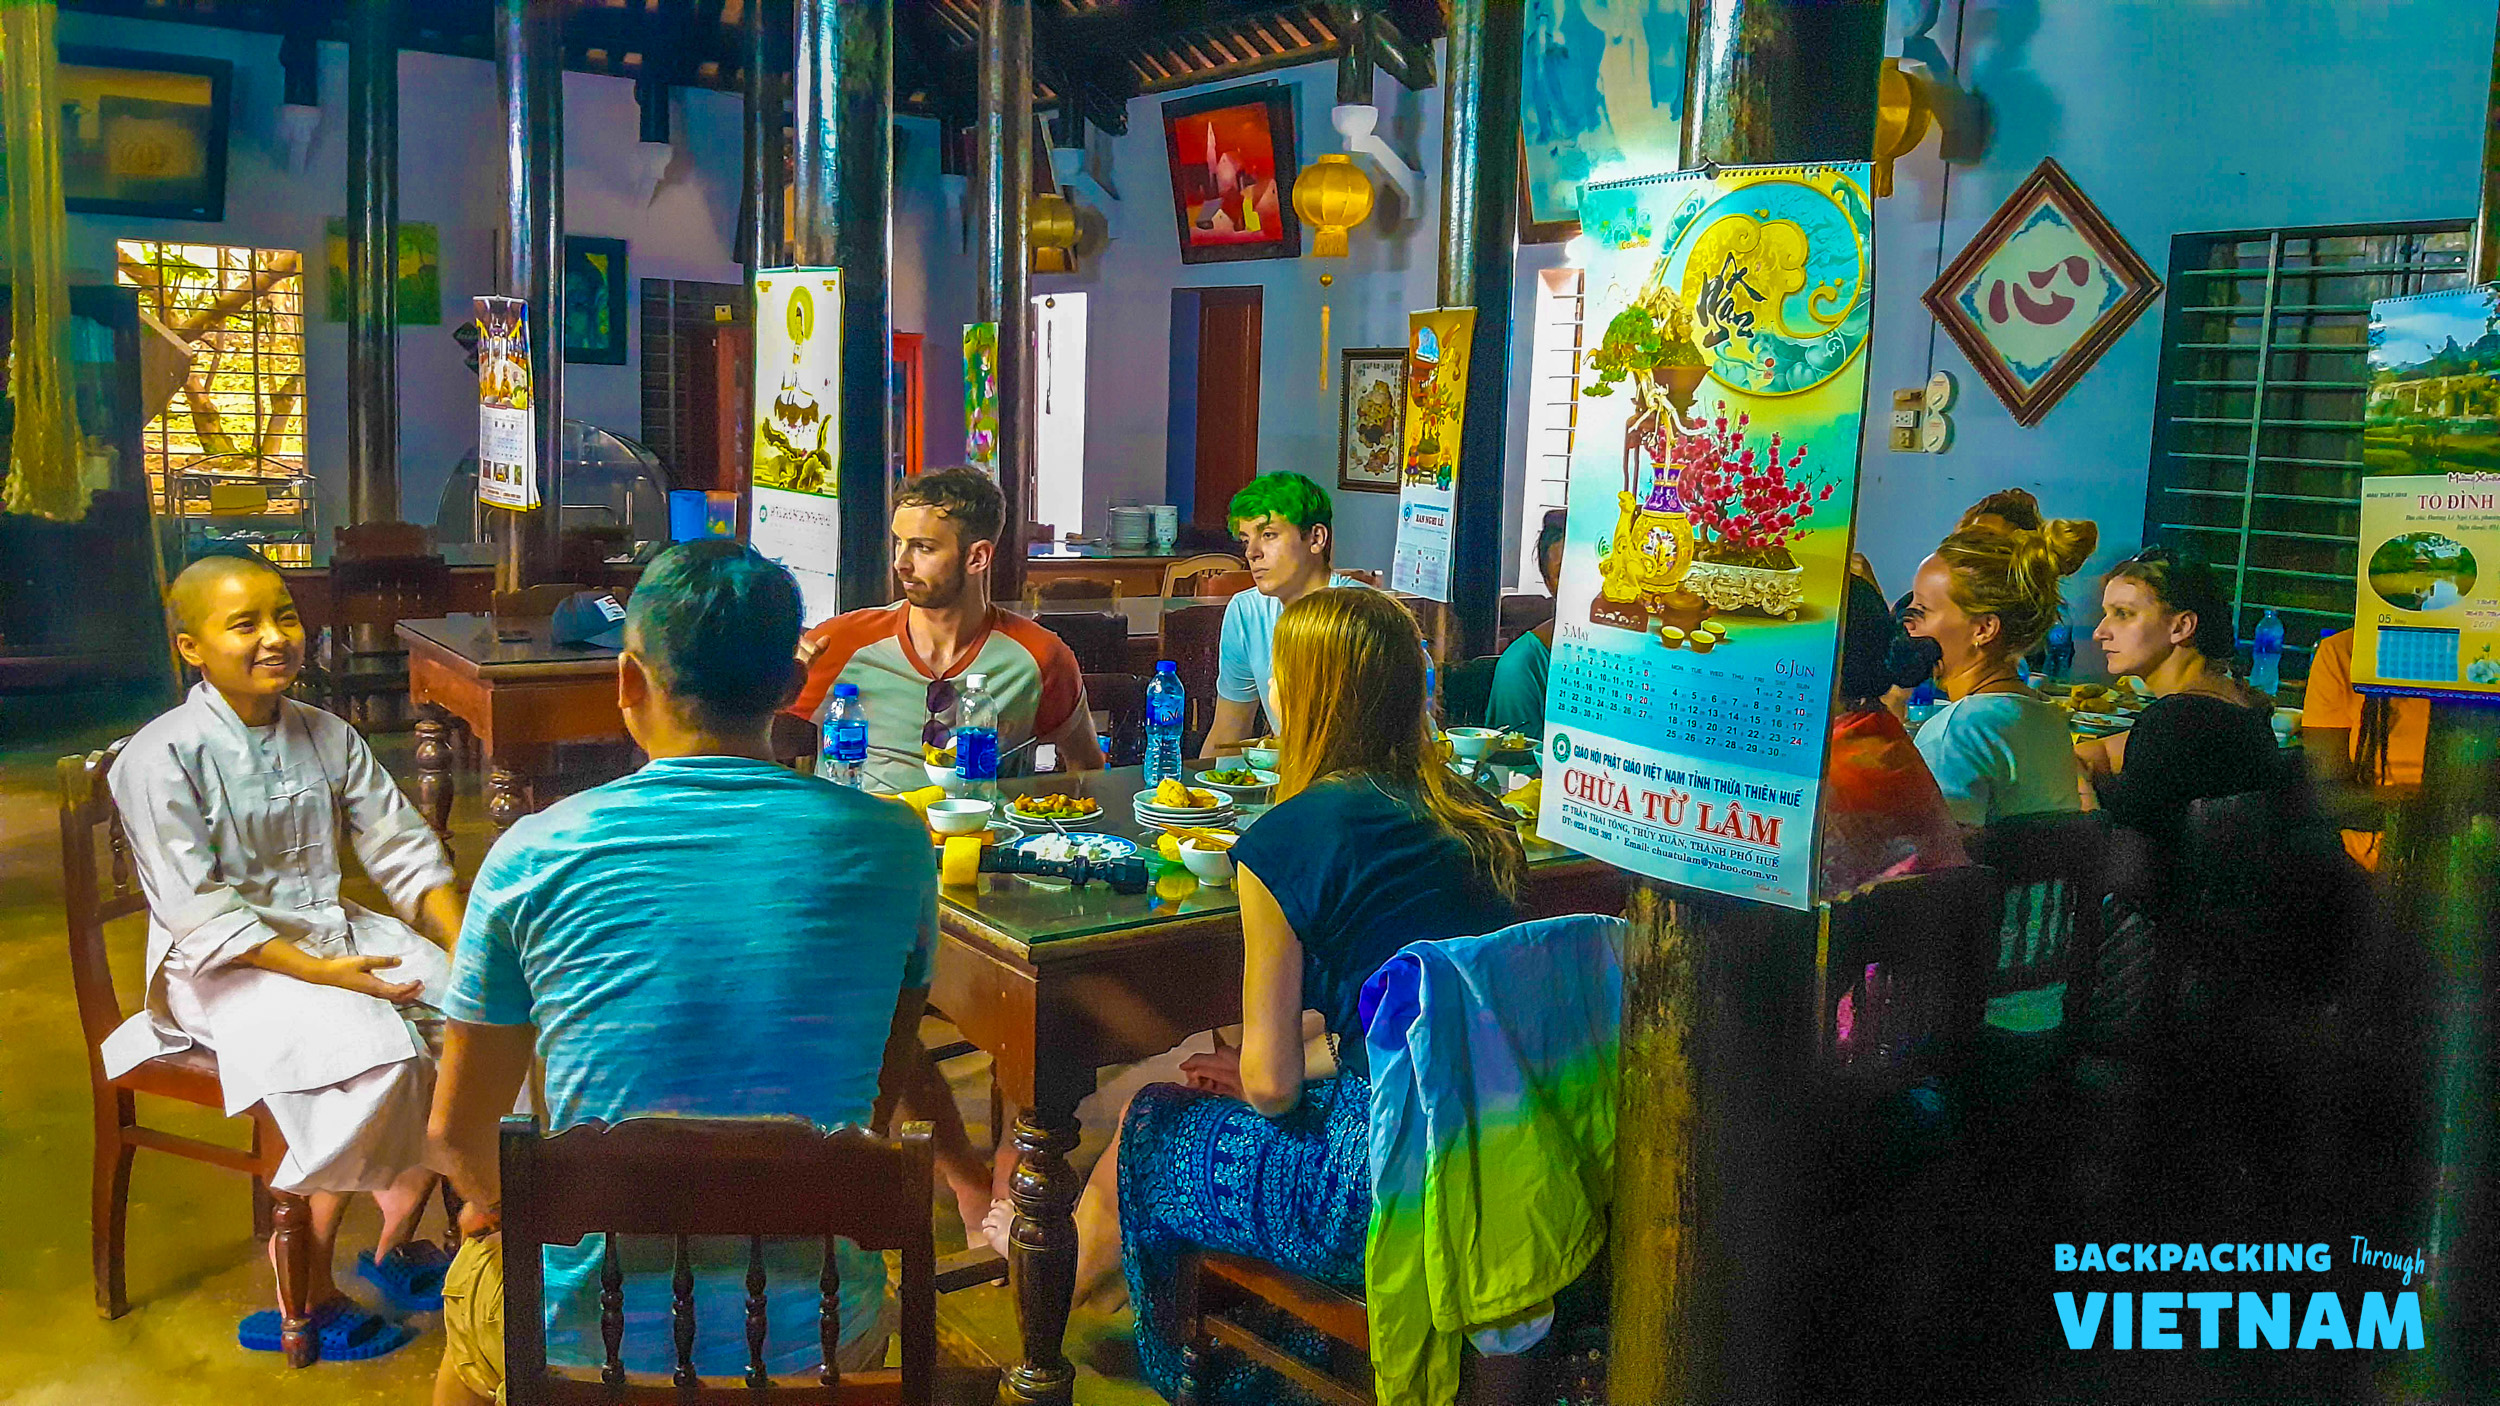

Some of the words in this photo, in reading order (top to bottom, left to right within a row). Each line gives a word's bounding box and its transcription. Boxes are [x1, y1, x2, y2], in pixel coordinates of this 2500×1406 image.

[1989, 256, 2089, 325] 心
[2448, 490, 2494, 509] ĐÌNH
[2378, 614, 2391, 623] 05
[1588, 670, 1592, 678] 9
[1612, 676, 1619, 684] 11
[1602, 660, 1606, 668] 3
[1628, 666, 1633, 674] 5
[1573, 680, 1580, 688] 15
[1586, 683, 1592, 691] 16
[1612, 690, 1618, 698] 18
[1559, 690, 1566, 698] 21
[1584, 696, 1591, 704] 23
[1610, 703, 1617, 711] 25
[1623, 706, 1631, 714] 26
[1639, 710, 1647, 718] 27
[1584, 709, 1590, 717] 30
[1732, 698, 1738, 706] 7
[1795, 708, 1805, 716] 10
[1668, 716, 1677, 724] 18
[1687, 720, 1696, 728] 19
[1707, 723, 1717, 731] 20
[1727, 726, 1736, 734] 21
[1748, 730, 1759, 738] 22
[1790, 737, 1802, 745] 24
[1688, 706, 1698, 714] 12
[1708, 709, 1718, 717] 13
[1750, 716, 1760, 724] 15
[1793, 723, 1803, 731] 17
[1666, 730, 1676, 738] 25
[1685, 734, 1696, 742] 26
[1706, 737, 1716, 745] 27
[1746, 744, 1757, 752] 29
[1768, 748, 1779, 756] 30
[1574, 745, 1589, 759] GIÁO
[1590, 748, 1602, 765] HỘI
[1603, 753, 1620, 771] PHẬT
[1623, 758, 1641, 774] GIÁO
[1643, 762, 1662, 782] VIỆT
[1665, 769, 1685, 785] NAM
[1688, 770, 1710, 790] TỈNH
[1714, 778, 1740, 796] THỪA
[1745, 784, 1776, 802] THIÊN
[1779, 789, 1804, 807] HUẾ
[1564, 769, 1632, 814] CHÙA
[1641, 788, 1689, 825] TỪ
[1696, 801, 1782, 847] LÂM
[1624, 838, 1649, 852] Email:
[1652, 848, 1778, 881] chuatulam@yahoo.com.vn
[1658, 833, 1687, 849] XUÂN,
[1690, 841, 1726, 856] THÀNH
[1730, 849, 1752, 861] PHỐ
[1756, 856, 1779, 867] HUẾ
